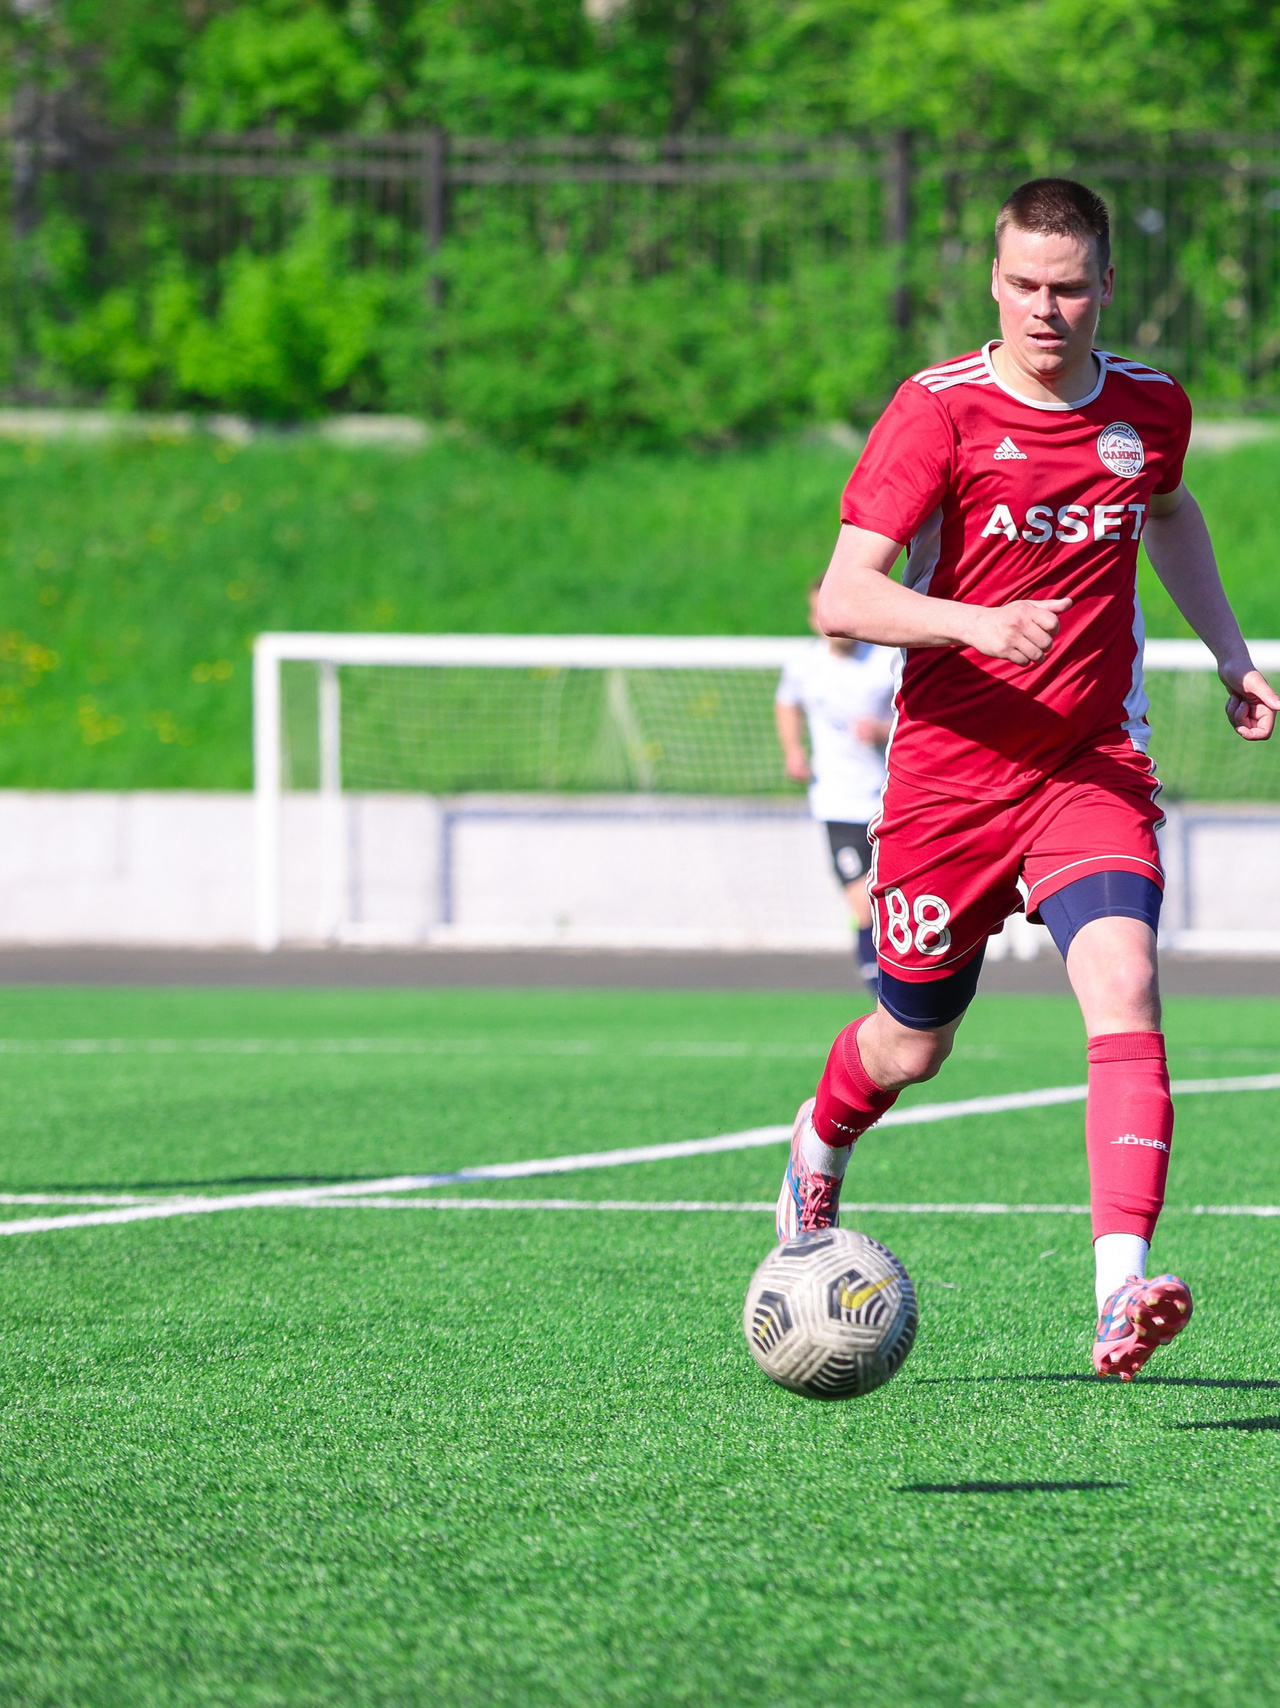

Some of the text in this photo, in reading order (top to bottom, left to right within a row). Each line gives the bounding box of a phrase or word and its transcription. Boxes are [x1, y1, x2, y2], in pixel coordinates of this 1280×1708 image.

[993, 450, 1028, 460] adidas
[1102, 450, 1142, 461] ОЛИМП
[980, 503, 1146, 543] ASSET
[884, 887, 952, 955] 88
